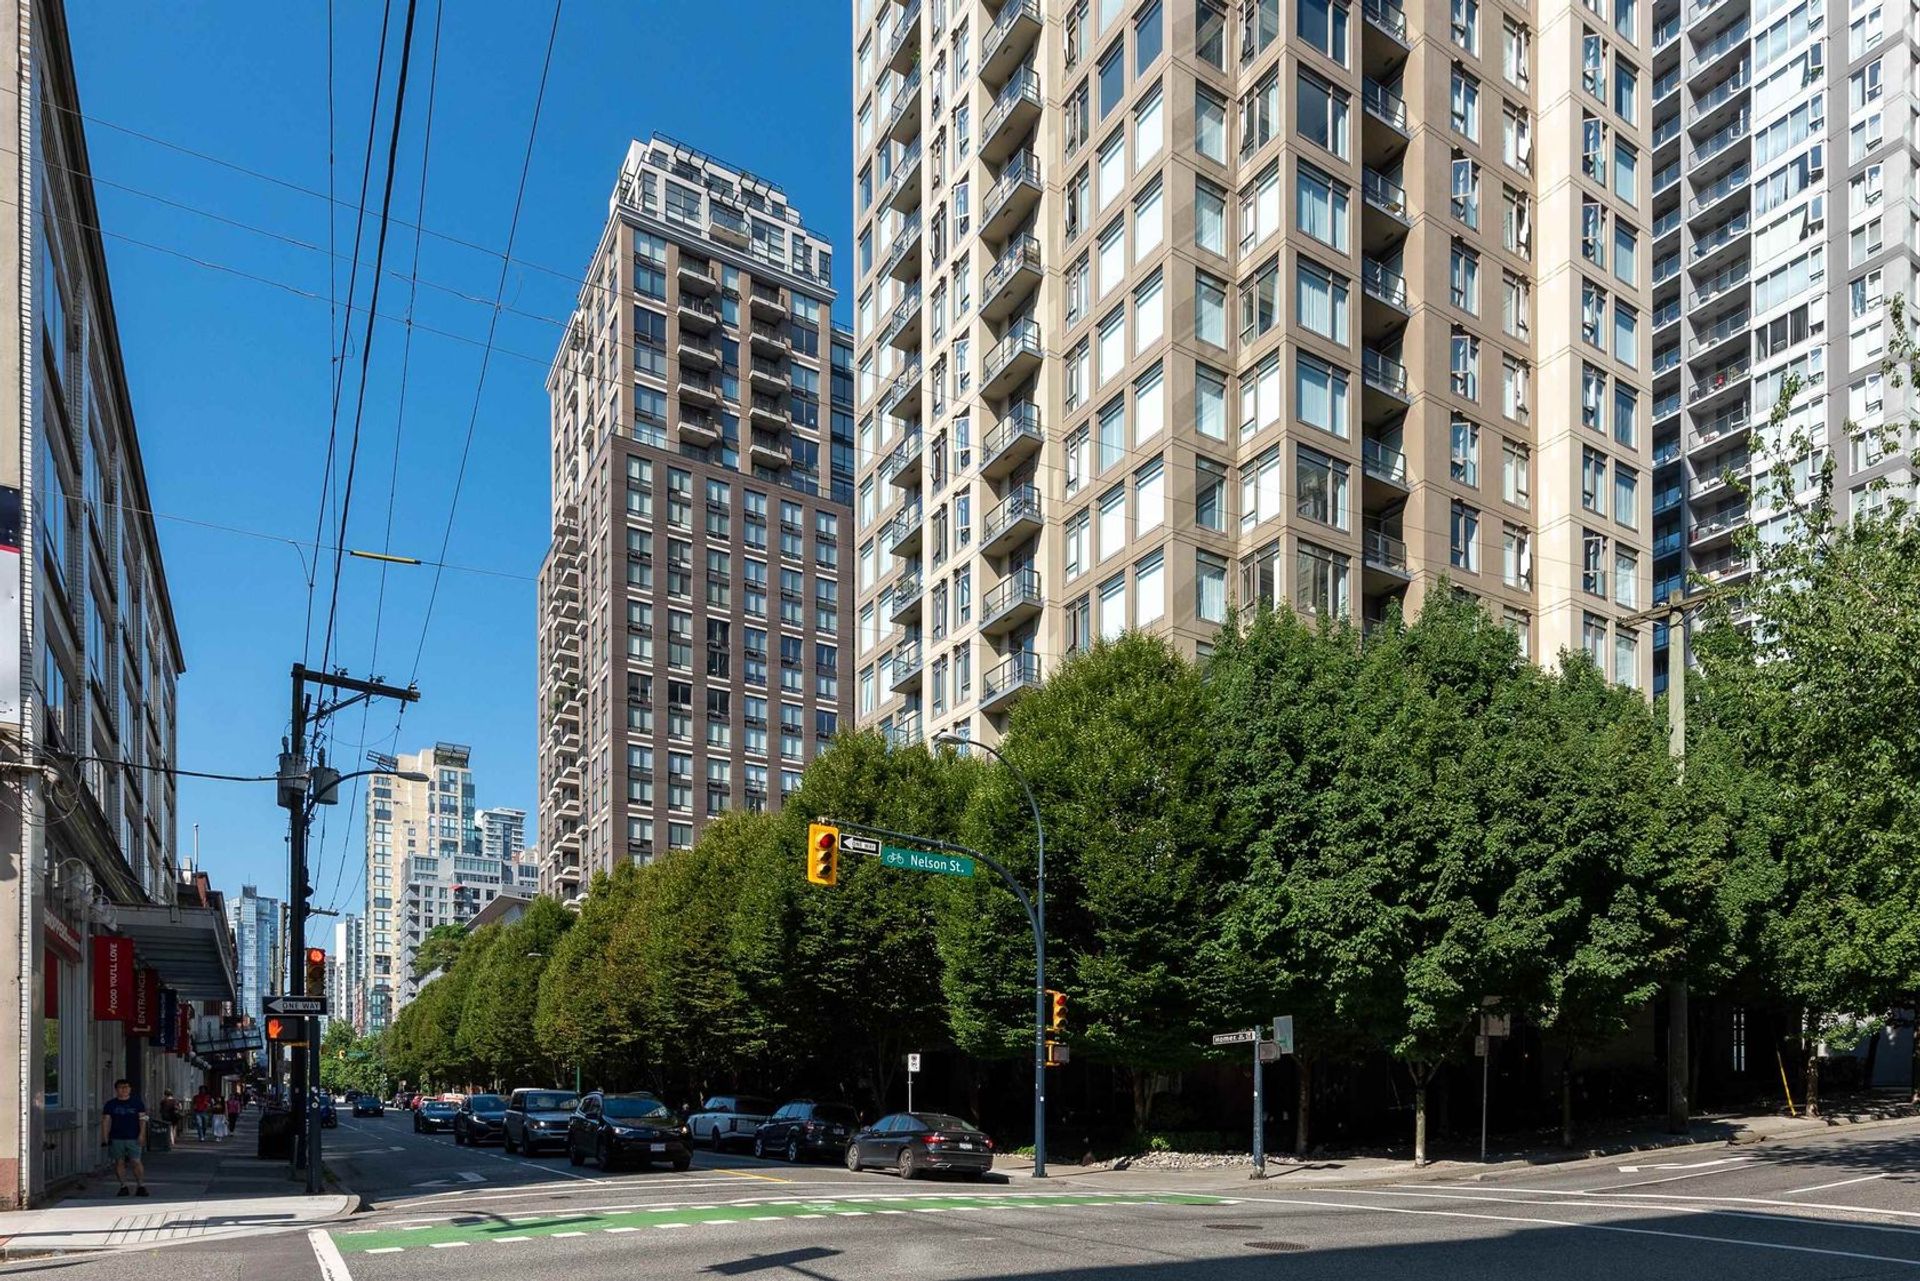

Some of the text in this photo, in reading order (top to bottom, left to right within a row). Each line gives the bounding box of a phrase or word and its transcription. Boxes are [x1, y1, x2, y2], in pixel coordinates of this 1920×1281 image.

[911, 854, 965, 873] Nelson St.
[109, 943, 118, 1008] FOOD YOU'LL LOVE
[137, 971, 147, 1024] ENTRANCE
